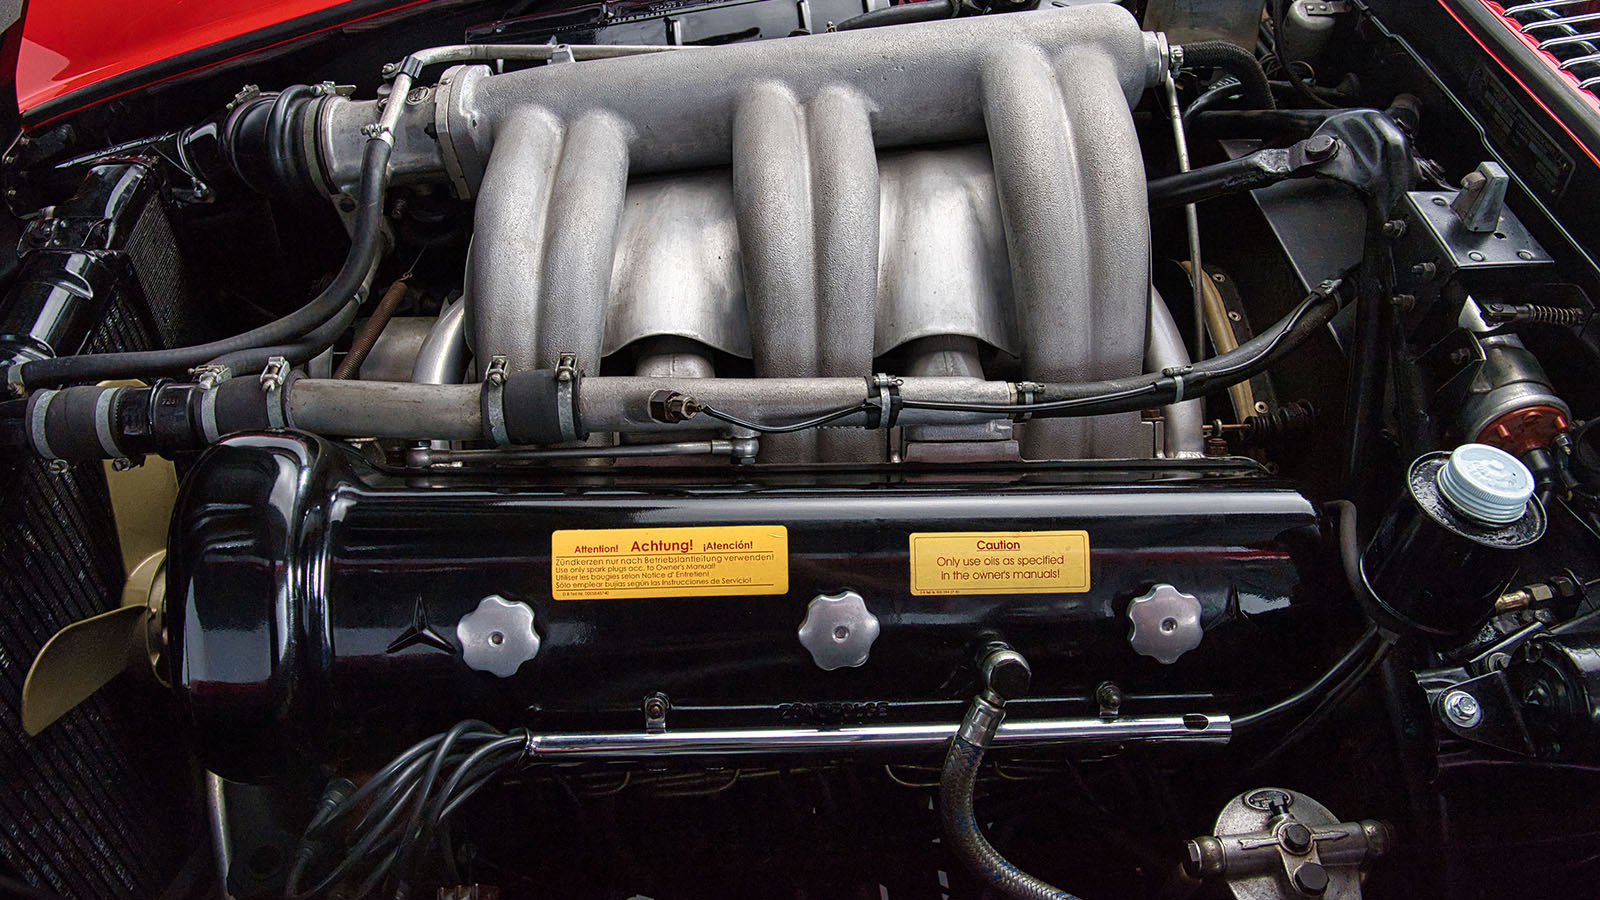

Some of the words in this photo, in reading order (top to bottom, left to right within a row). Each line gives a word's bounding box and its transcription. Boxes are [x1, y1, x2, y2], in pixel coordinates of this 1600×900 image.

[574, 544, 618, 554] Attention!
[630, 539, 693, 554] Achtung!
[703, 540, 753, 552] ¡Atención!
[976, 540, 1021, 550] Caution
[555, 558, 604, 567] Zündkerzen
[620, 557, 643, 565] nach
[724, 553, 774, 562] verwenden!
[936, 556, 960, 568] Only
[963, 557, 981, 566] use
[1002, 557, 1015, 565] as
[1017, 555, 1064, 567] specified
[570, 567, 585, 575] only
[587, 566, 606, 574] spark
[607, 566, 627, 574] plugs
[952, 570, 970, 580] the
[972, 570, 1010, 580] owner's
[1012, 569, 1060, 579] manuals!
[591, 573, 620, 582] bougies
